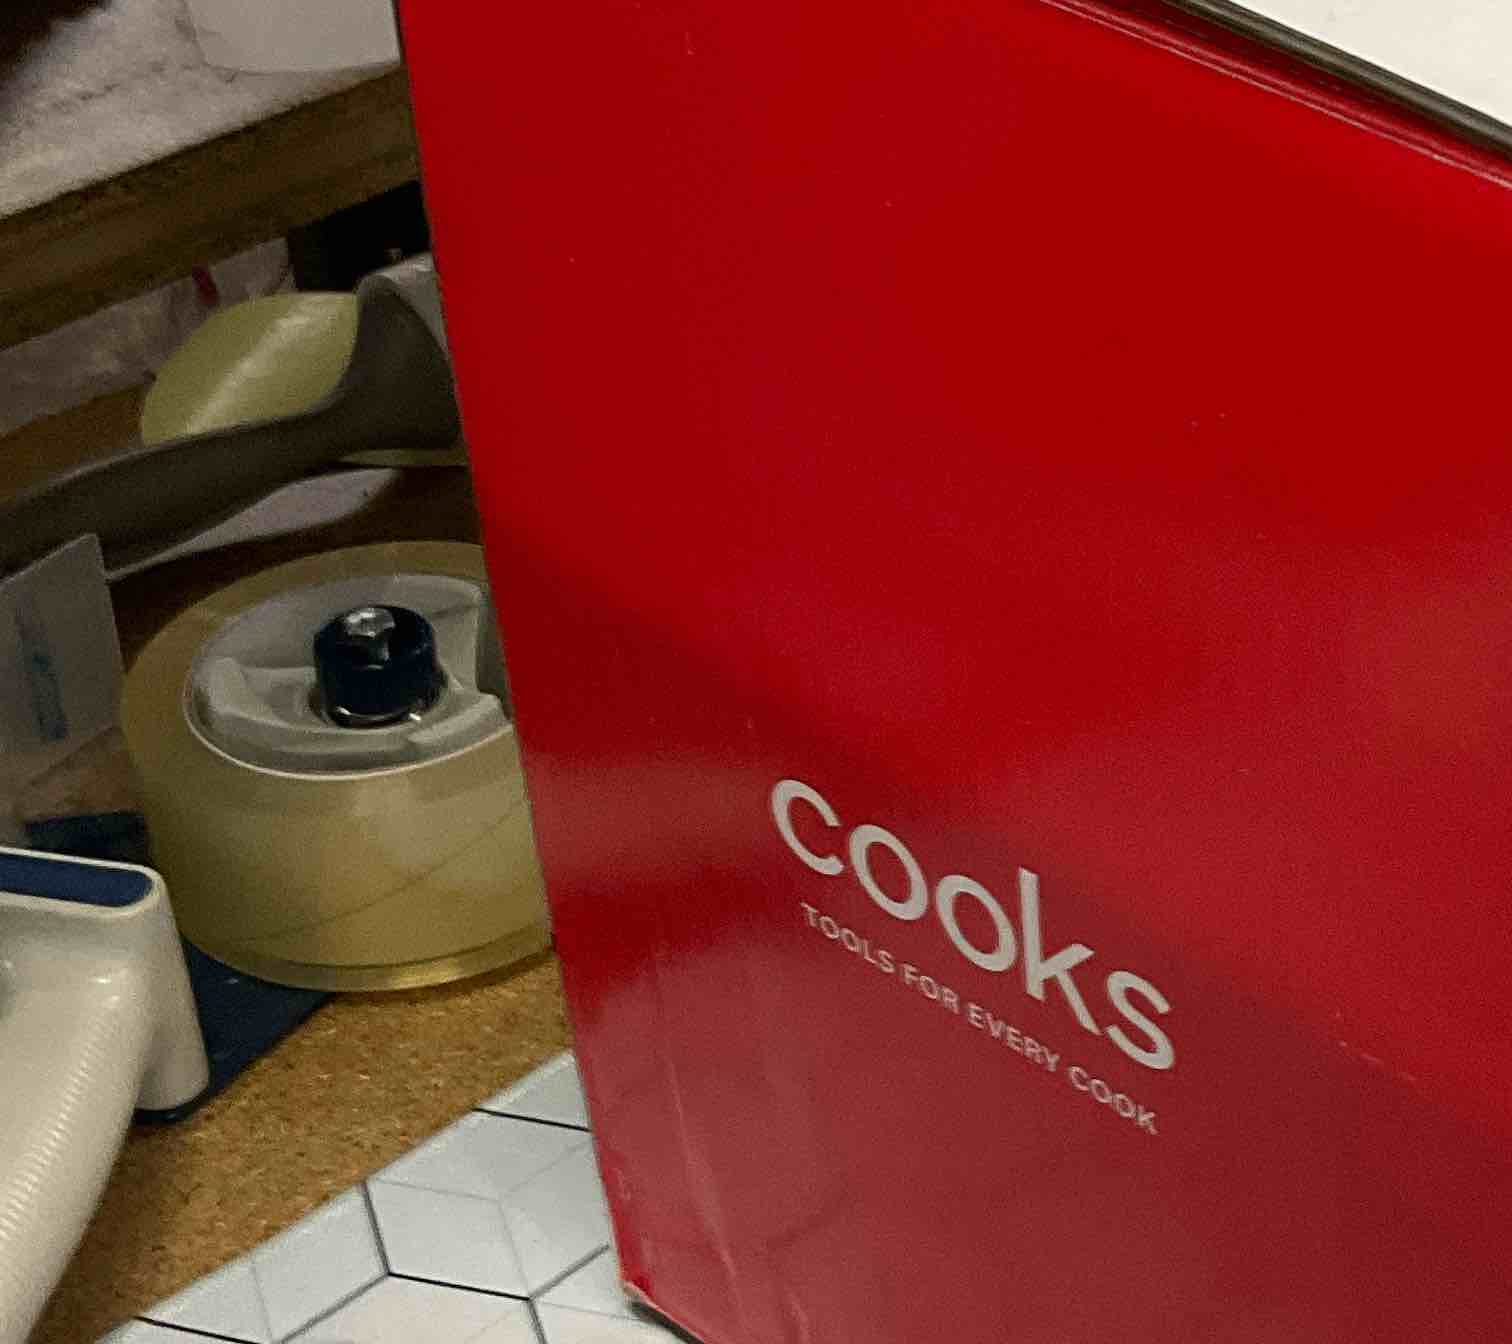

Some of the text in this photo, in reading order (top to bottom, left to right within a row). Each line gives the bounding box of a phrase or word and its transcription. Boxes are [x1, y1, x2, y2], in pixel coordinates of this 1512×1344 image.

[770, 778, 1176, 1071] cooks
[800, 902, 1160, 1136] TOOLS FOR EVERY COOK
